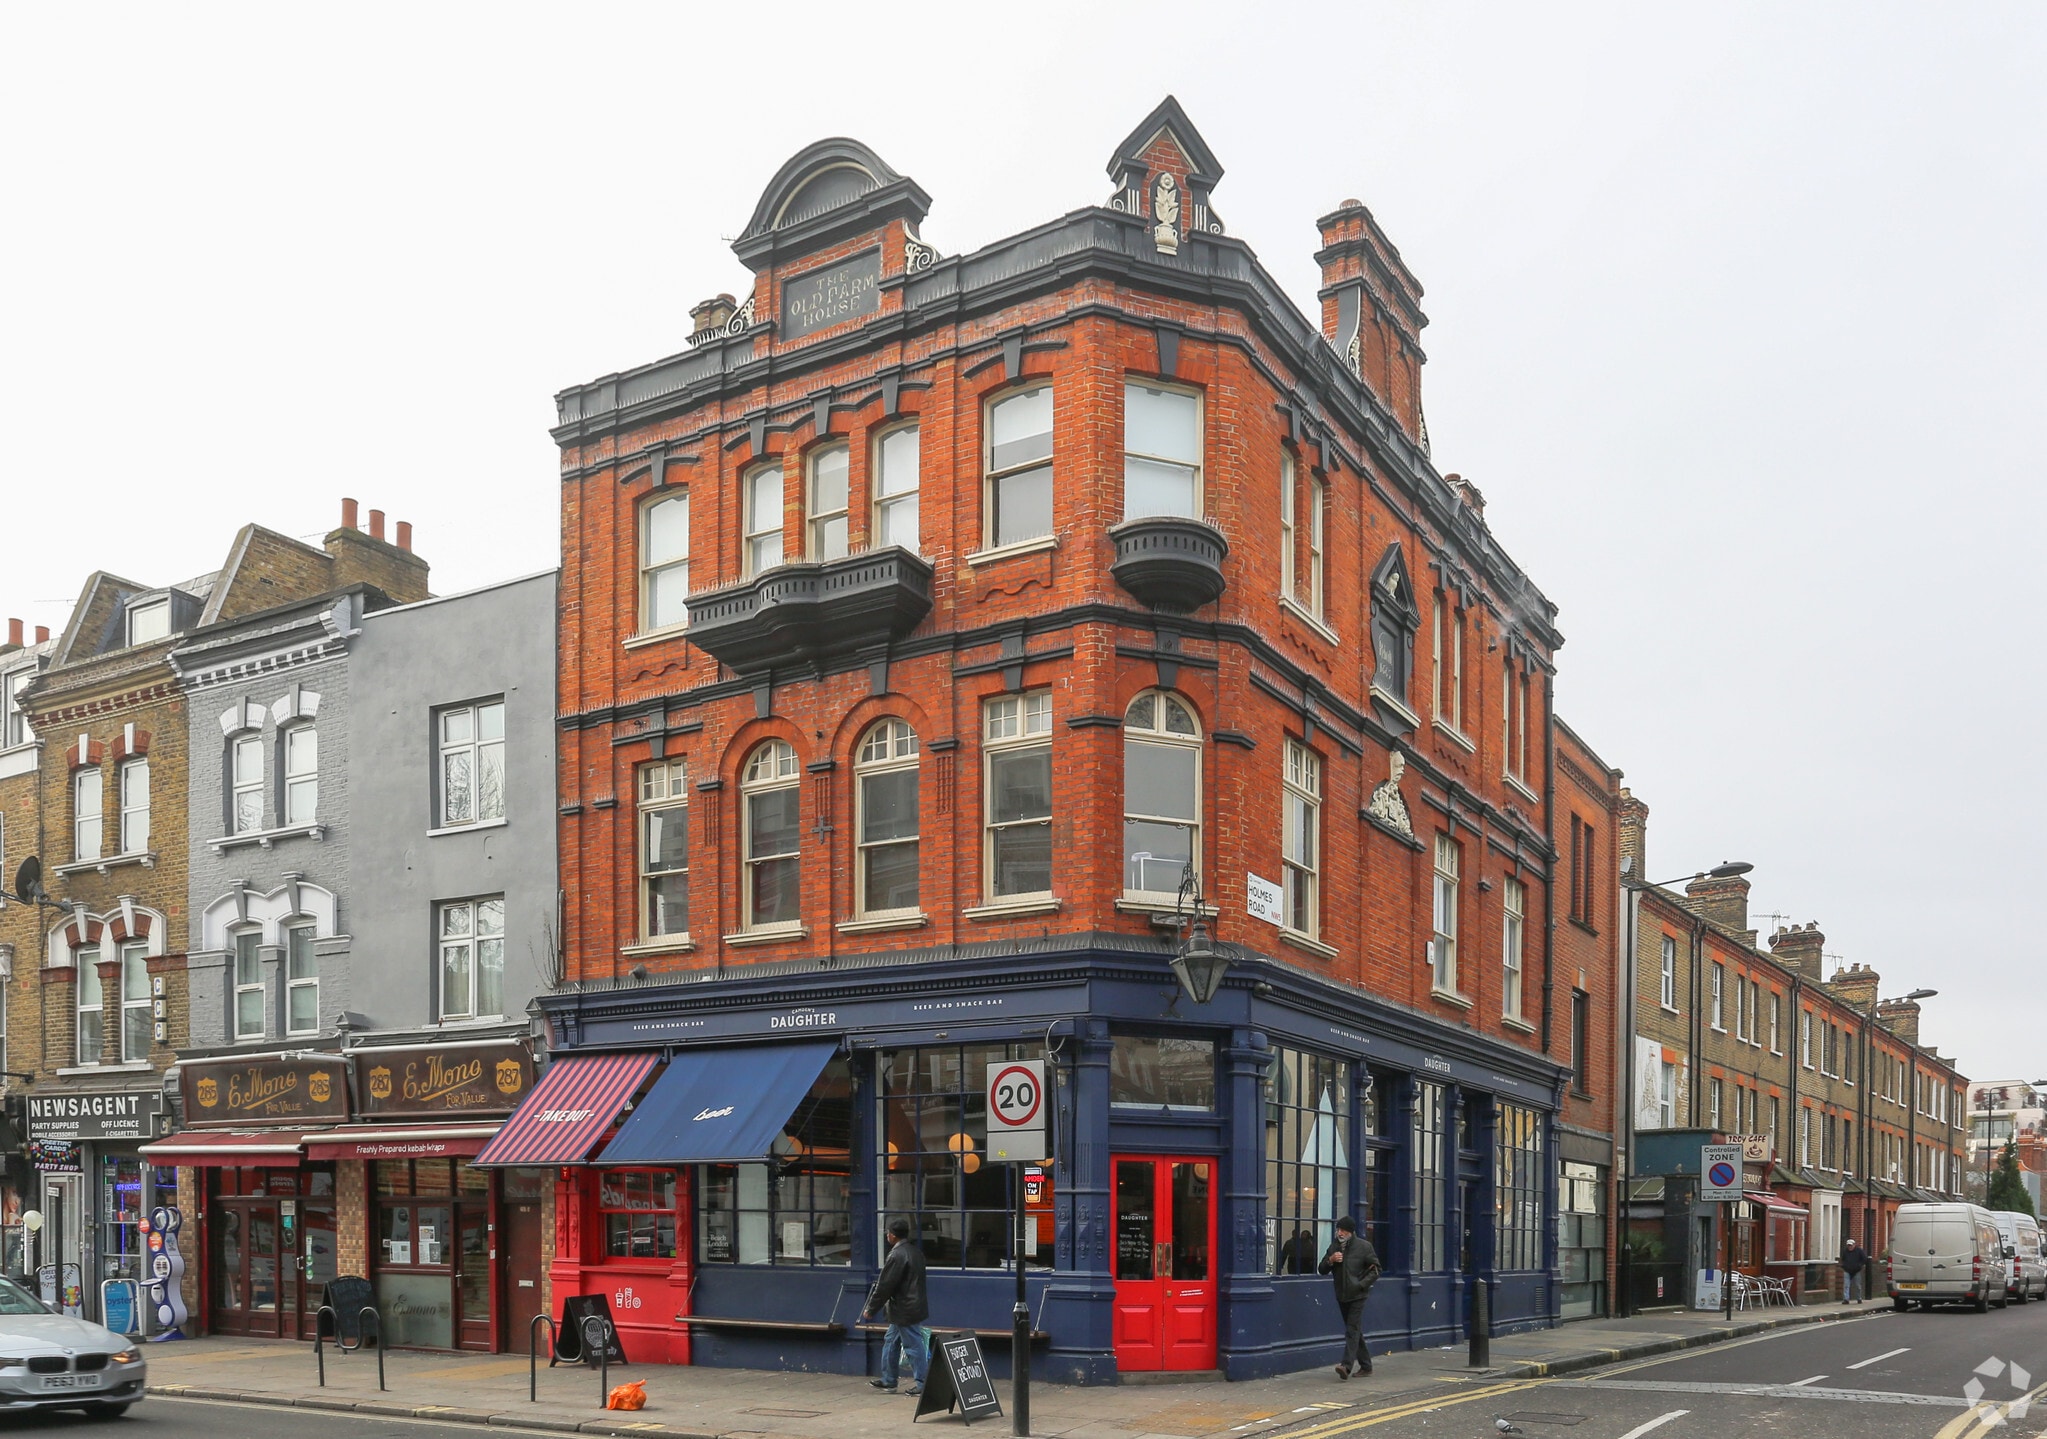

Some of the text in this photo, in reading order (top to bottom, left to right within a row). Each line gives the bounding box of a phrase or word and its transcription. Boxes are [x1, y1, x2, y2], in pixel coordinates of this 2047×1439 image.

[816, 269, 849, 290] THE
[790, 273, 874, 316] OLD FARM
[802, 295, 861, 327] HOUSE
[1248, 884, 1273, 904] HOLMES
[1248, 899, 1265, 914] ROAD
[1270, 910, 1281, 921] NW5
[956, 1000, 983, 1008] SNACK
[651, 1022, 665, 1030] AND
[770, 1012, 836, 1028] DAUGHTER
[1424, 1057, 1451, 1073] DAUGHTER
[371, 1075, 391, 1093] 287
[498, 1068, 519, 1088] 287
[200, 1084, 218, 1102] 285
[311, 1079, 330, 1097] 285
[998, 1082, 1034, 1110] 20
[31, 1095, 139, 1118] NEWSAGENT
[692, 1105, 735, 1121] beer
[539, 1109, 589, 1122] TAKE OUT
[31, 1120, 80, 1130] PARTY SUPPLIES
[100, 1119, 140, 1129] OFF LICENCE
[1728, 1135, 1766, 1143] TROY CAFE
[356, 1146, 377, 1156] Freshly
[378, 1144, 407, 1154] Prepared
[34, 1162, 58, 1170] PARTY
[1024, 1175, 1045, 1183] AMDEN
[107, 1296, 133, 1307] oyster
[949, 1345, 969, 1360] BURGER
[957, 1365, 982, 1383] BEYOND
[968, 1394, 988, 1403] DAUGHTER
